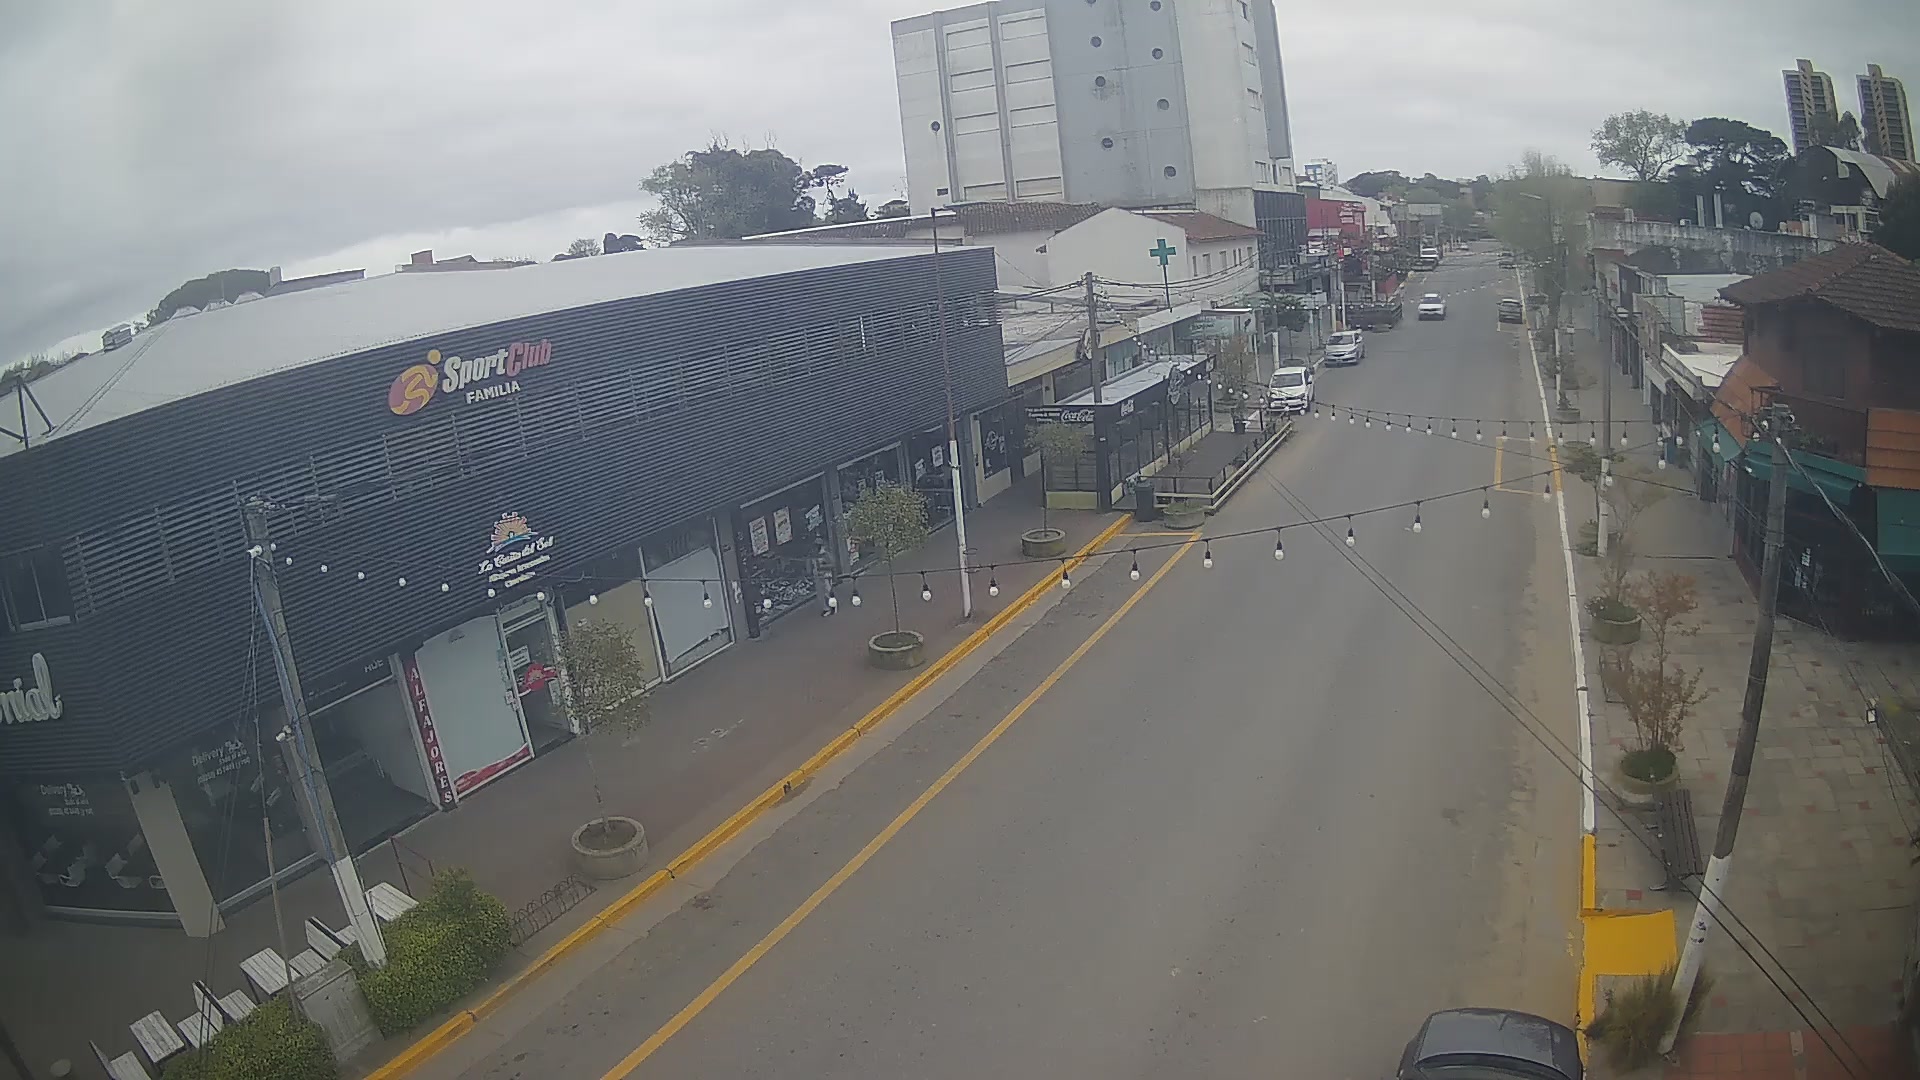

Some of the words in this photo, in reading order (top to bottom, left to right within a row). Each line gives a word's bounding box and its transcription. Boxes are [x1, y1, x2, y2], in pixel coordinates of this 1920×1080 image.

[466, 381, 521, 404] FAMILIA
[478, 559, 494, 575] La
[0, 652, 64, 724] nial
[411, 667, 452, 803] ALFAJORES
